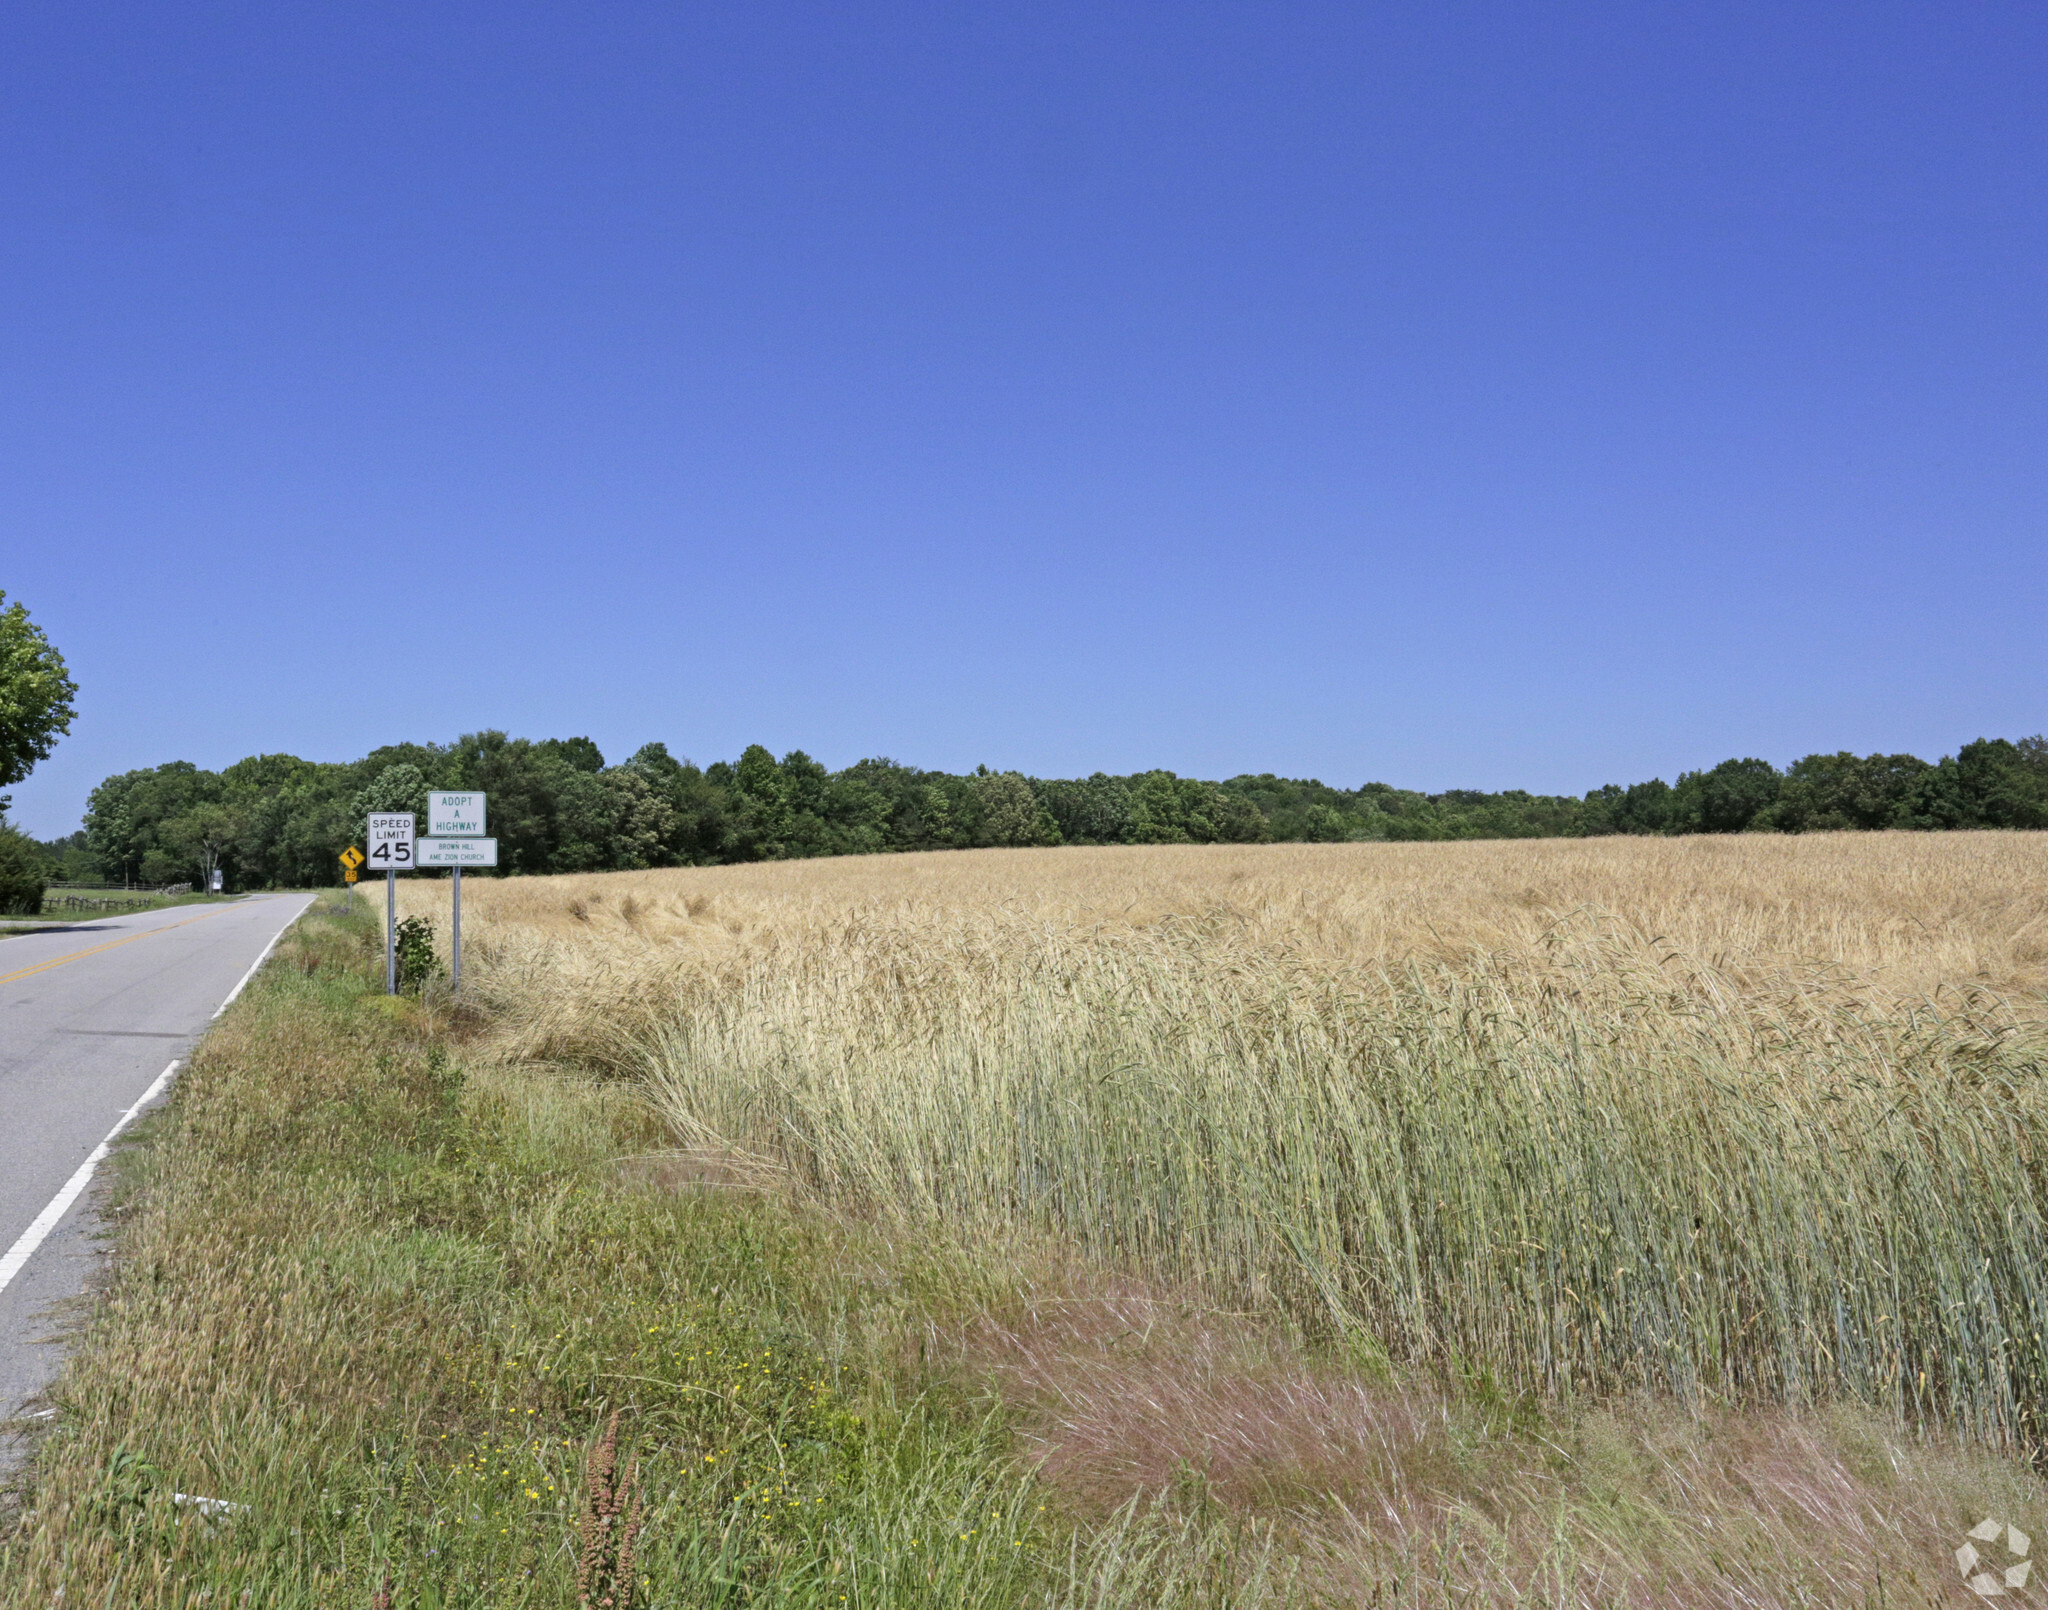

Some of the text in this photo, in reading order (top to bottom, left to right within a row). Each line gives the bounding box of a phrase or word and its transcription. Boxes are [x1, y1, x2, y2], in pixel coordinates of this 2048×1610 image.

[442, 796, 472, 806] ADOPT
[454, 810, 460, 818] A
[372, 820, 410, 828] SPEED
[436, 822, 478, 831] HIGHWAY
[376, 831, 406, 840] LIMIT
[372, 842, 410, 862] 45
